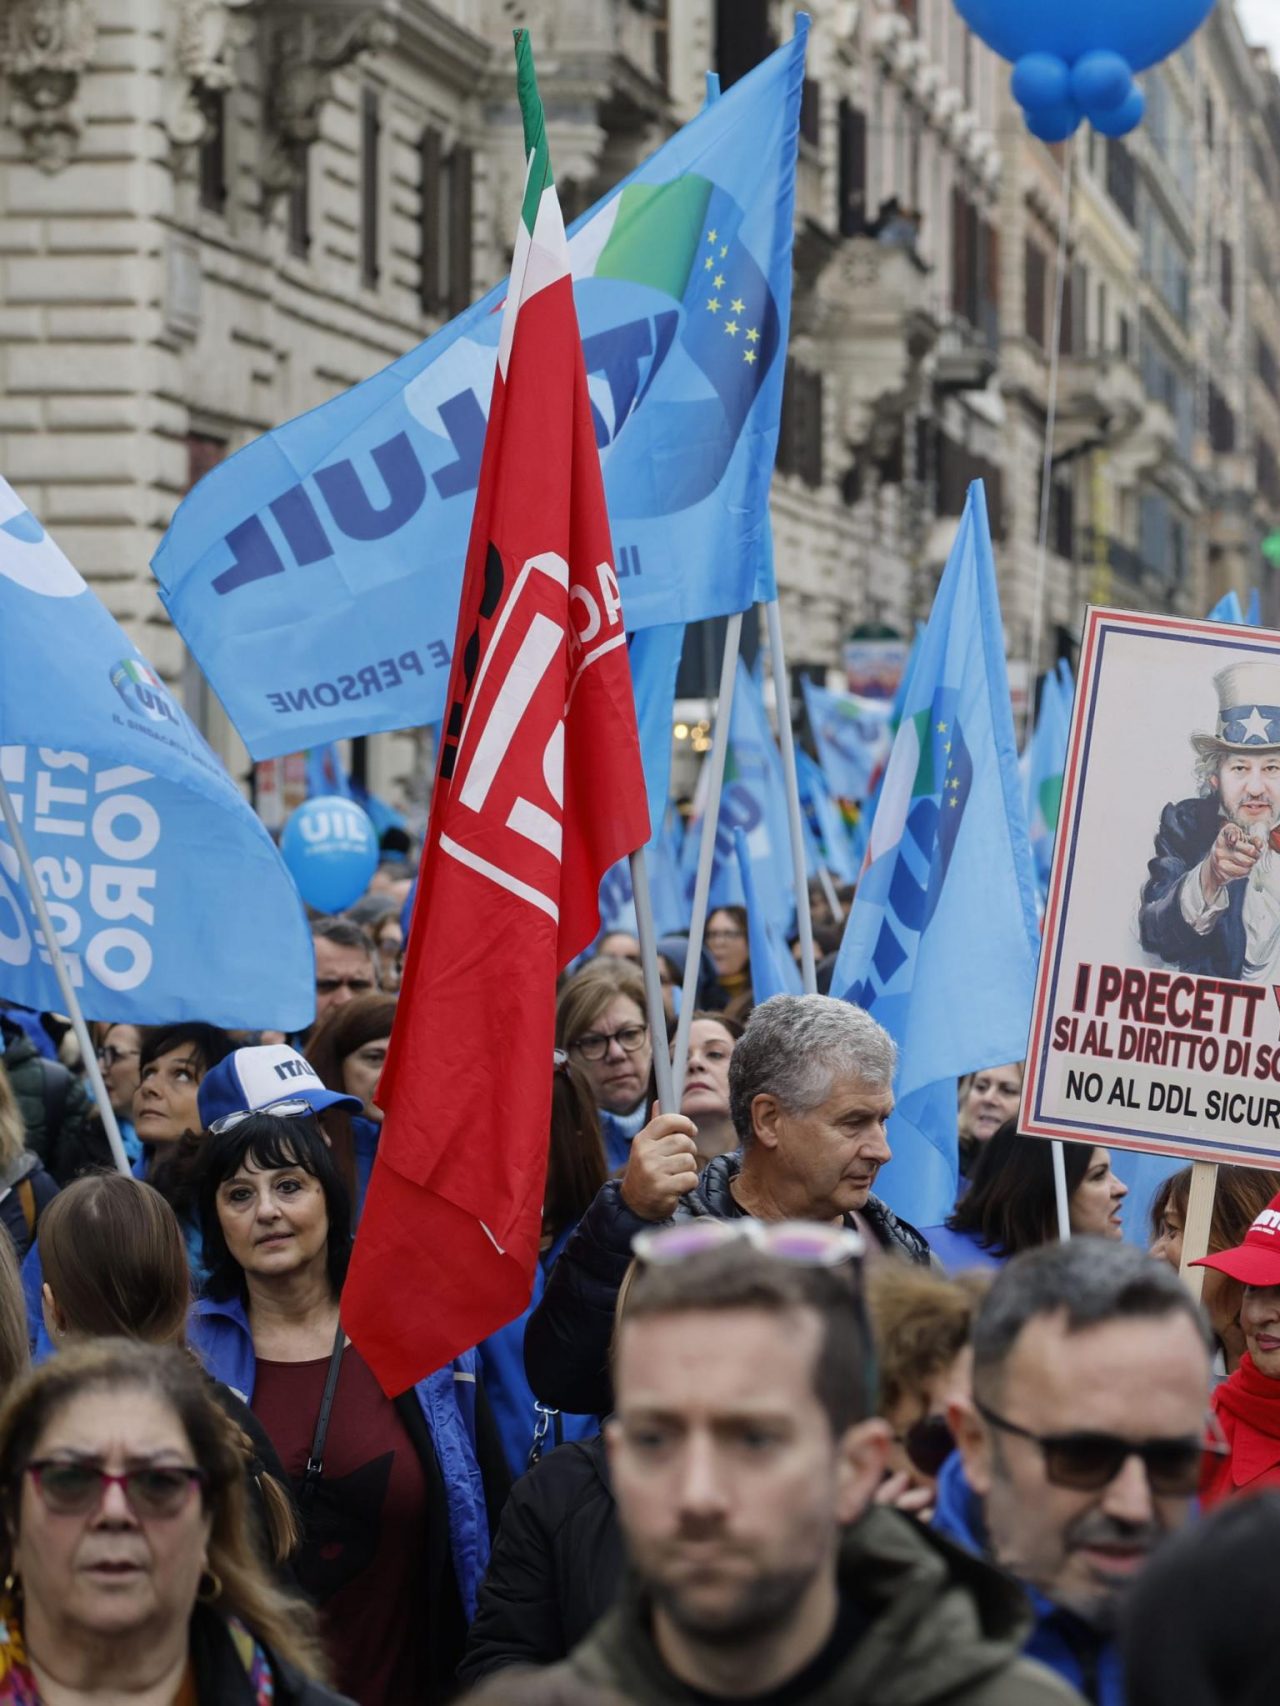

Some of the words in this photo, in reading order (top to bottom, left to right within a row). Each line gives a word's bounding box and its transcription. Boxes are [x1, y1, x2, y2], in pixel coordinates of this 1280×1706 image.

[134, 683, 180, 727] UIL
[298, 811, 367, 843] UIL
[1071, 962, 1092, 1012] I
[1095, 965, 1266, 1038] PRECETT
[1052, 1015, 1079, 1053] SI
[1080, 1020, 1114, 1058] AL
[1117, 1024, 1220, 1073] DIRITTO
[1223, 1039, 1252, 1077] DI
[1065, 1069, 1104, 1103] NO
[1107, 1076, 1141, 1109] AL
[1148, 1081, 1198, 1118] DDL
